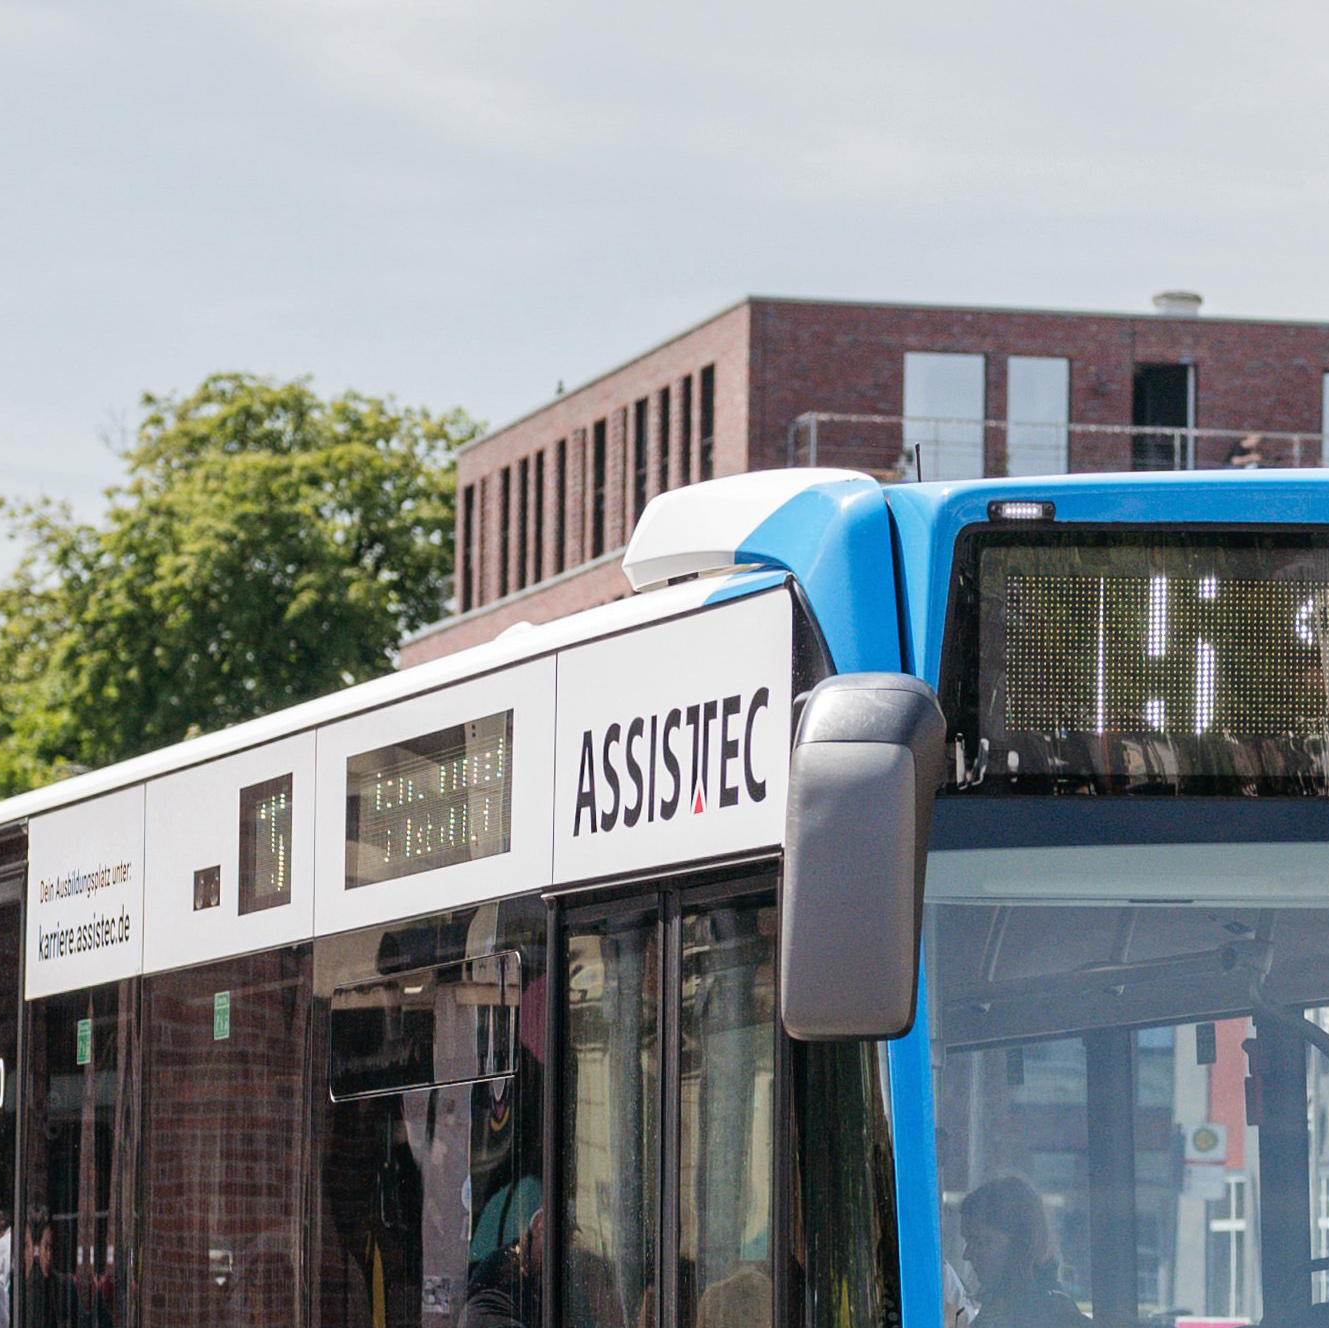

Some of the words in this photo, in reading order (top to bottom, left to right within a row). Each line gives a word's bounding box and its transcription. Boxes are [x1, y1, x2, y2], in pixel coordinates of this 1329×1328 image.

[573, 687, 769, 837] ASSISTEC
[39, 877, 54, 904] Dein
[55, 863, 111, 900] Ausbildungsplatz
[112, 860, 132, 886] unter:
[38, 904, 130, 962] karriere.assistec.de
